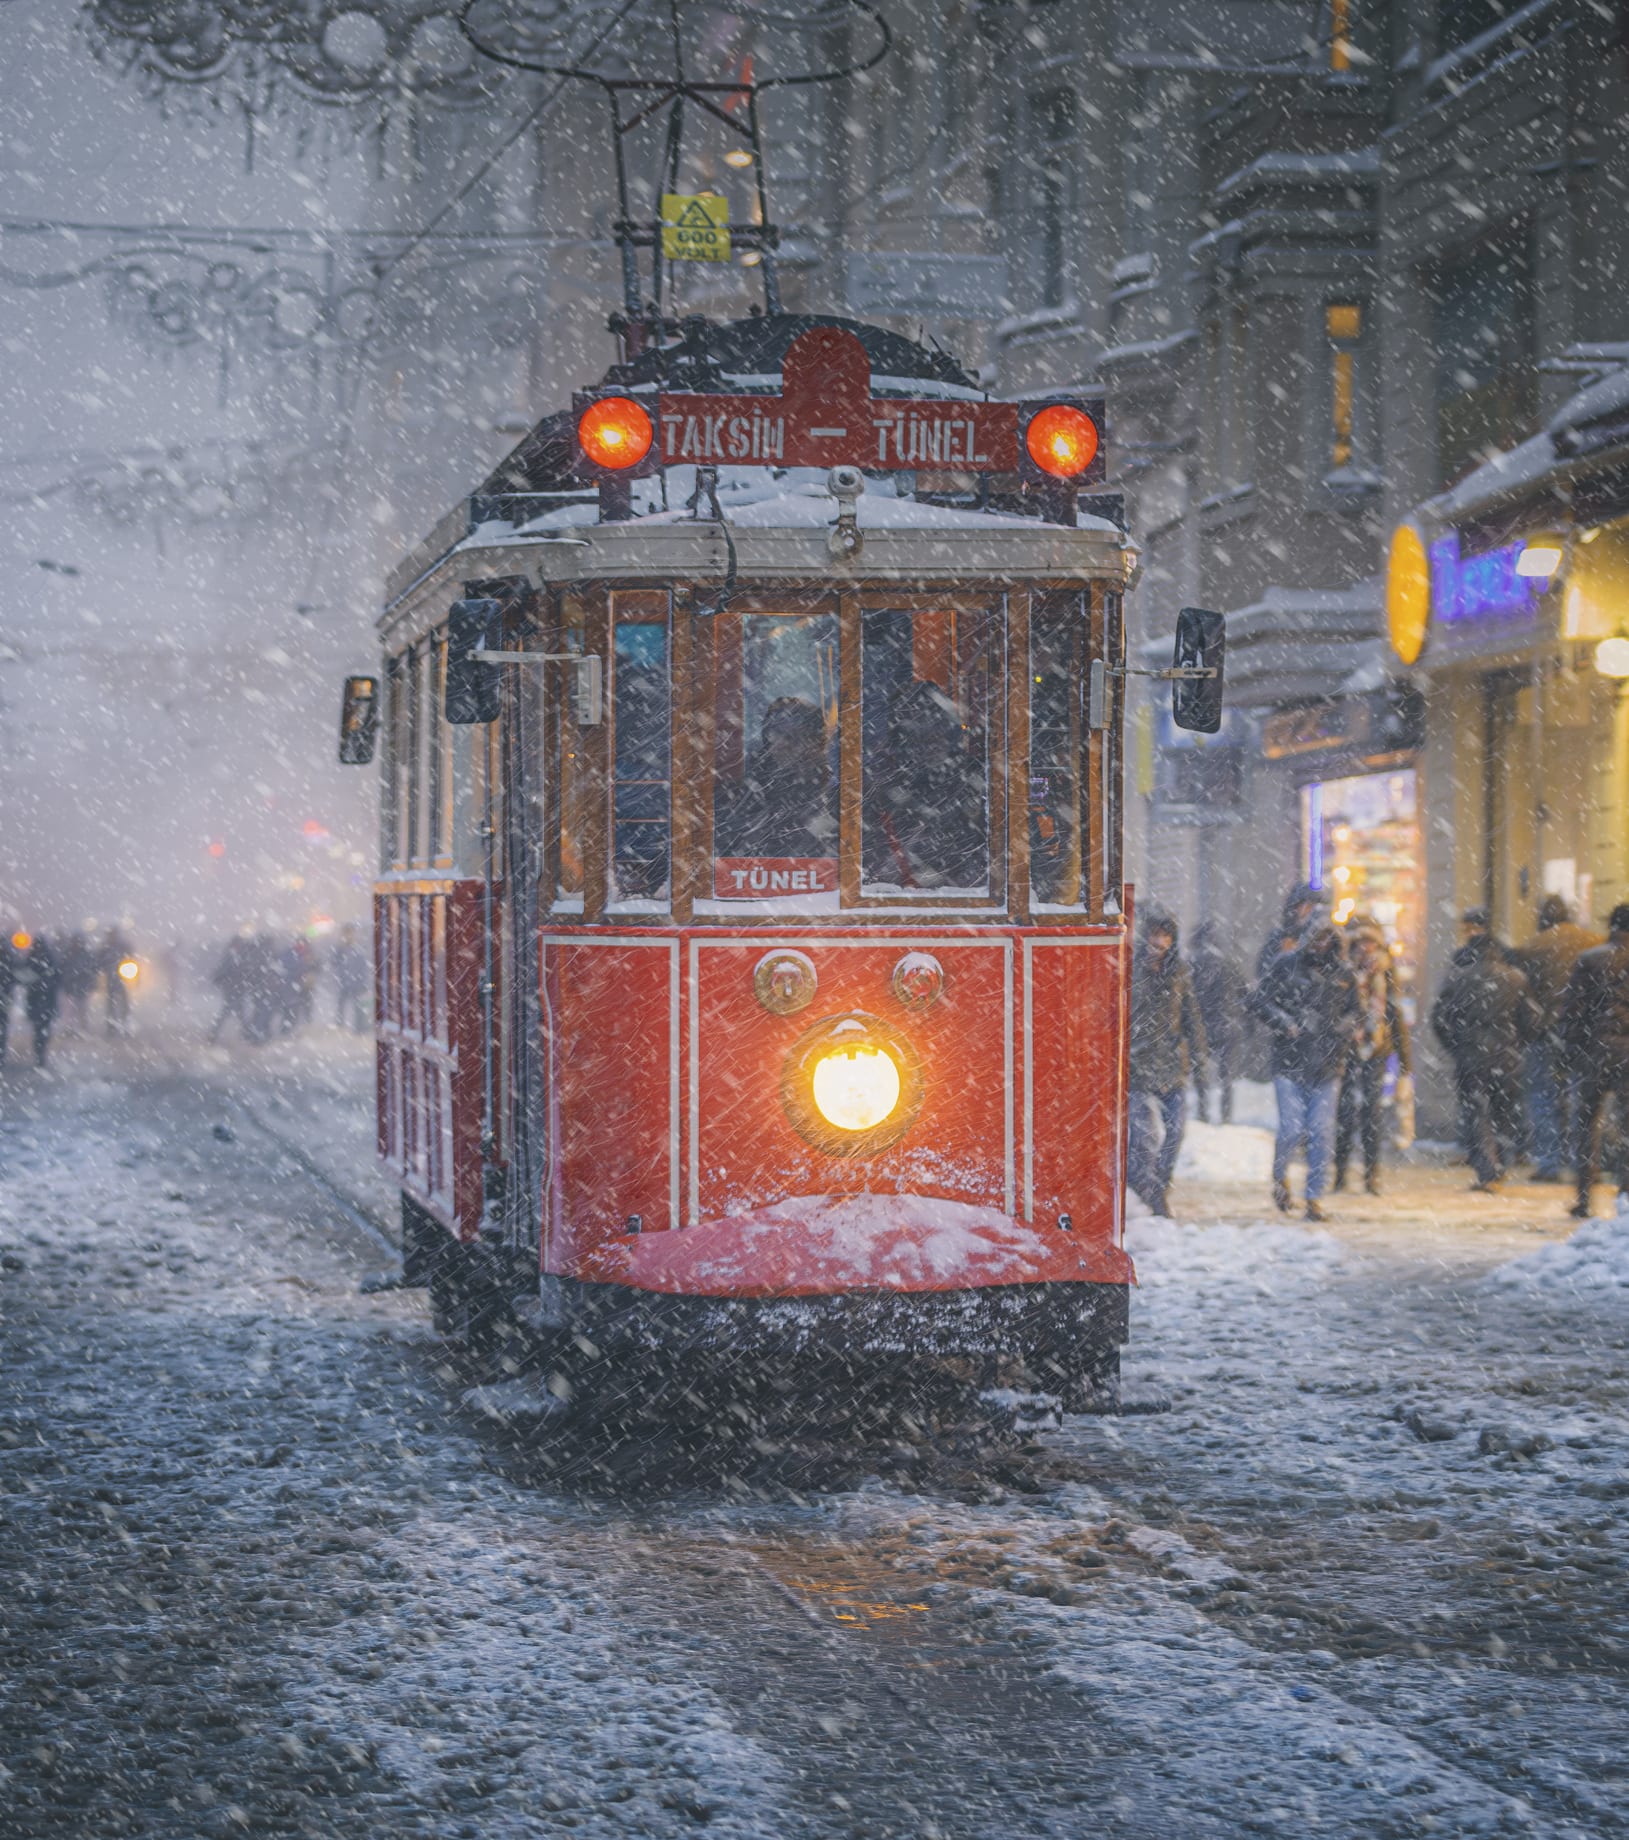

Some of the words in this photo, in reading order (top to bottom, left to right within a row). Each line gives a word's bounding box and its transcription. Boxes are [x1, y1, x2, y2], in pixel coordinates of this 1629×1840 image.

[677, 230, 717, 244] 600
[674, 247, 720, 258] VOLT
[662, 407, 785, 460] TAKSİM
[872, 411, 988, 463] TÜNEL
[731, 866, 825, 889] TÜNEL
